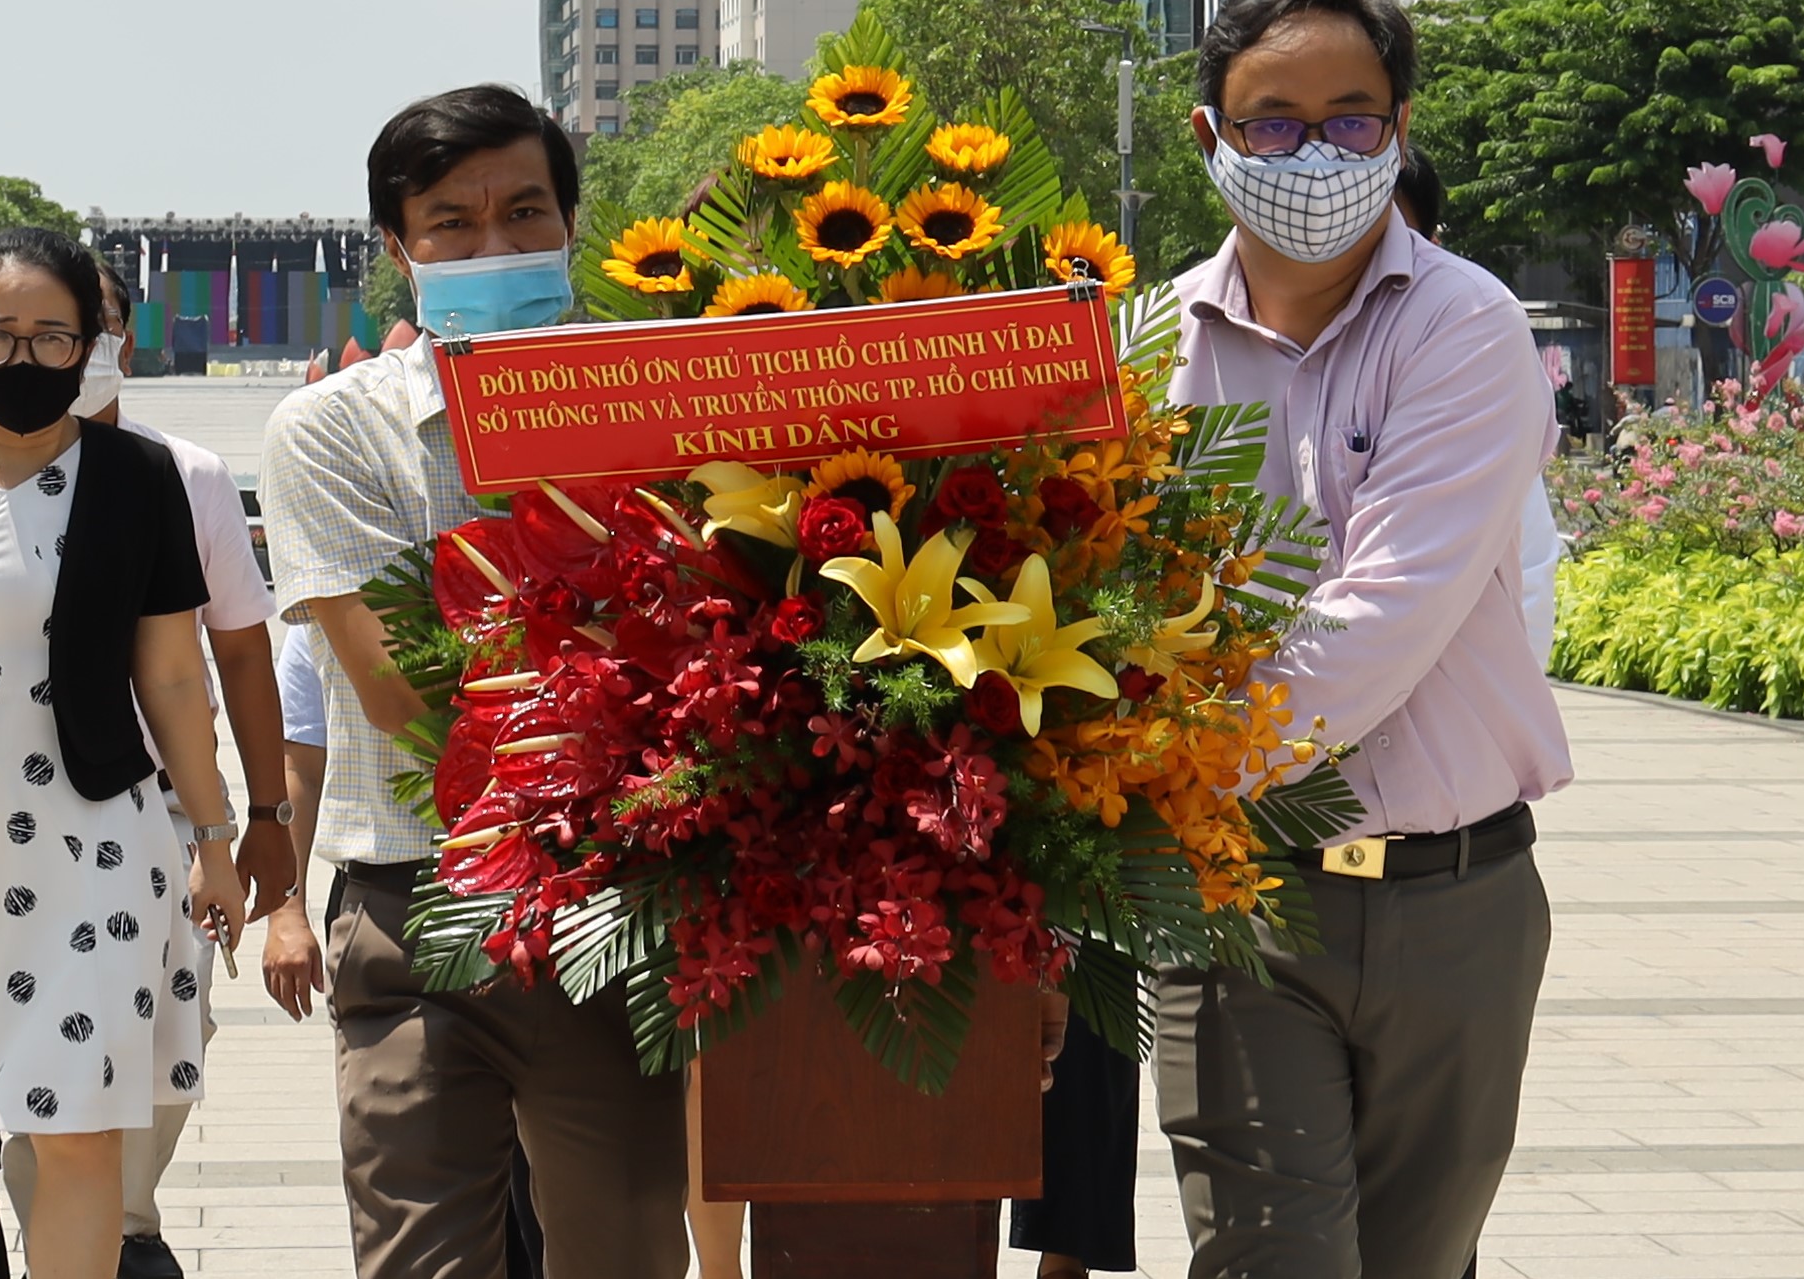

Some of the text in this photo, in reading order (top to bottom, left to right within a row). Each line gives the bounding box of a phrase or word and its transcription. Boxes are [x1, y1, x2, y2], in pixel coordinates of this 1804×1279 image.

[1712, 293, 1736, 306] SCB
[479, 322, 1076, 398] ĐỜI ĐỜI NHỚ ƠN CHỦ TỊCH HỒ CHÍ MINH VĨ ĐẠI
[476, 358, 1091, 435] SỞ THÔNG TIN VÀ TRUYỀN THÔNG TP. HỒ CHÍ MINH
[672, 414, 901, 458] KÍNH DÂNG
